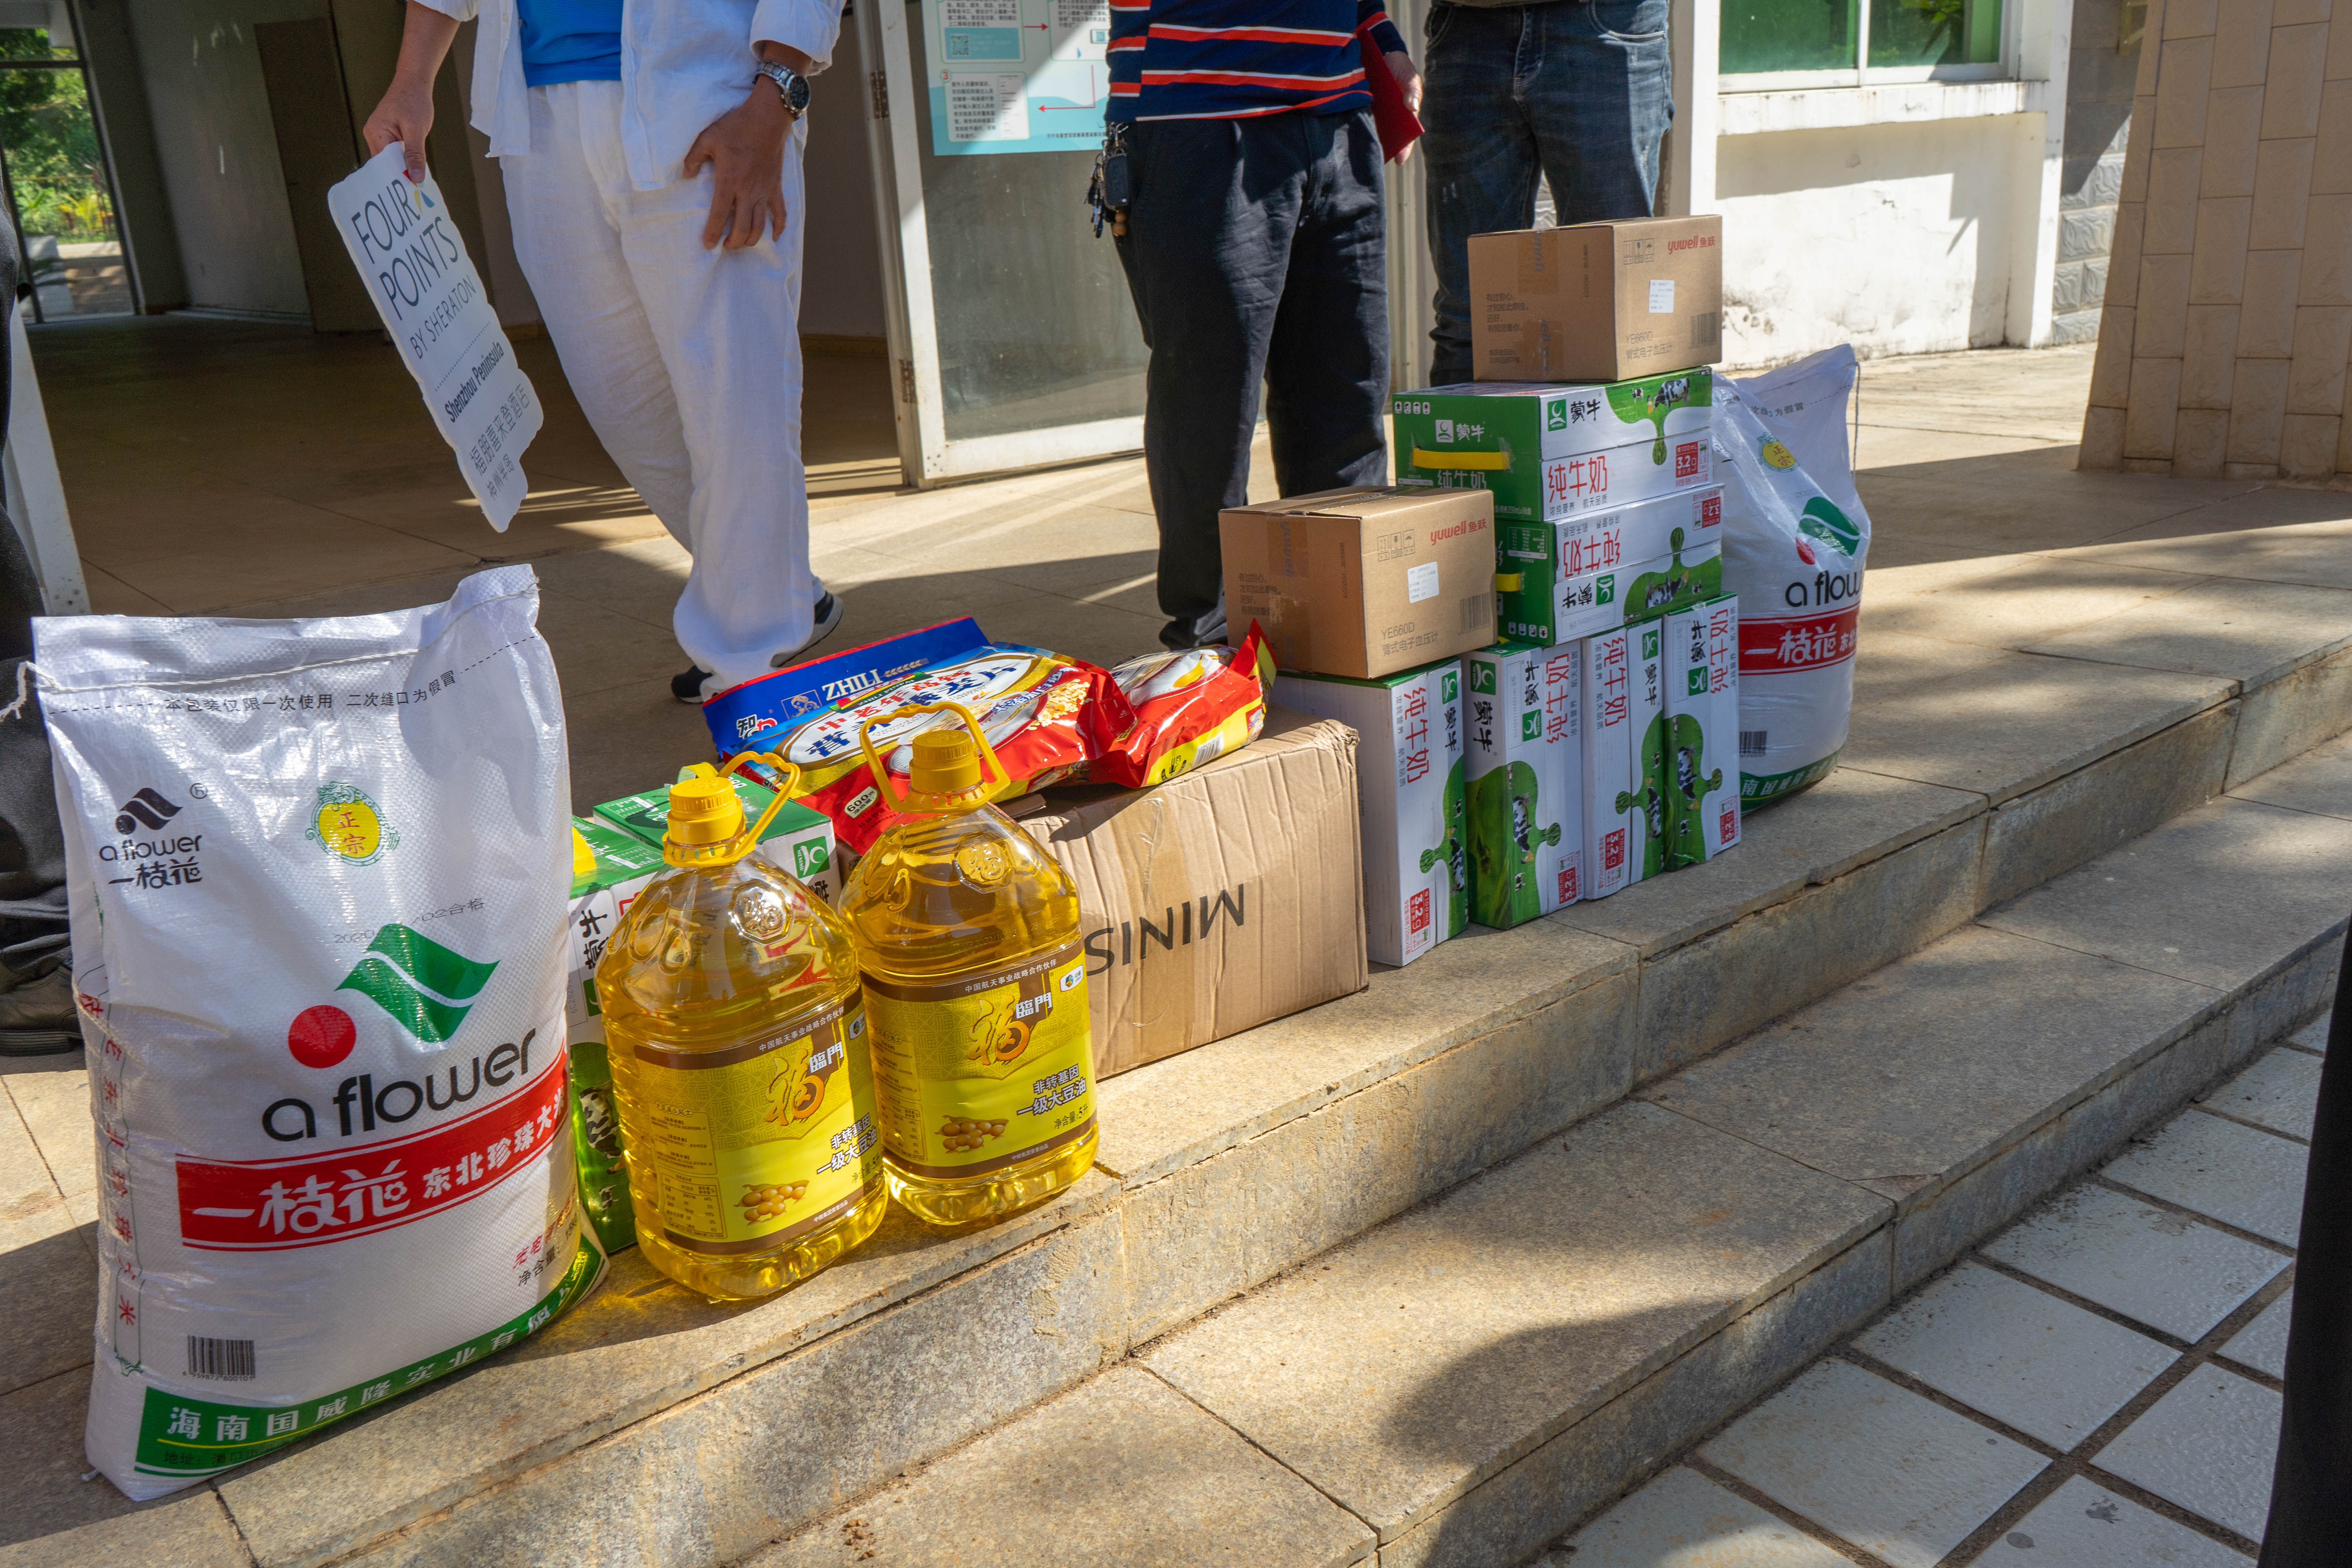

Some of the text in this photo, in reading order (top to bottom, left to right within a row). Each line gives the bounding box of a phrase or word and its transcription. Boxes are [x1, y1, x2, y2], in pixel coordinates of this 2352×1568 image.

[943, 71, 949, 80] 3
[351, 179, 420, 264] FOUR
[1668, 236, 1715, 254] yuwell 鱼跃
[379, 216, 459, 321] POINTS
[410, 274, 476, 359] BY SHERATON
[1625, 331, 1653, 346] YE660D
[1627, 343, 1673, 360] 臂式电子血压计
[445, 341, 505, 423] Shenzhou Peninsula
[469, 383, 530, 475] 福朋喜来登酒店
[1570, 398, 1602, 425] 蒙牛
[1456, 422, 1485, 443] 蒙牛
[1677, 454, 1697, 472] 3.2g
[1773, 441, 1791, 467] 正宗
[486, 453, 515, 502] 神州半岛
[1548, 455, 1608, 504] 纯牛奶
[1549, 494, 1608, 517] 浓纯营养 航天品质
[1702, 501, 1720, 517] 3.2g
[1430, 518, 1487, 546] yuwell 鱼跃
[1563, 514, 1621, 536] 浓纯营养 航天品质
[1563, 528, 1621, 579] 纯牛奶
[1562, 583, 1593, 609] 蒙牛
[1785, 570, 1863, 608] a flow
[1381, 622, 1415, 640] YE660D
[1383, 630, 1439, 656] 臂式电子血压计
[1690, 619, 1707, 663] 蒙牛
[1744, 623, 1837, 664] 一枝花
[1710, 609, 1729, 694] 纯牛奶
[164, 670, 457, 712] 本包装仅限一次使用 二次缝口为假冒
[817, 669, 971, 731] 中老年高钙
[822, 668, 884, 702] ZHILI
[857, 692, 882, 706] ZHILI
[883, 679, 916, 694] PINPAI
[1524, 660, 1539, 706] 蒙牛
[1546, 653, 1570, 744] 纯牛奶
[1570, 651, 1579, 736] 浓纯营养 航天品质
[1603, 638, 1626, 727] 纯牛奶
[1644, 664, 1657, 706] 蒙牛
[1404, 687, 1430, 784] 纯牛奶
[1444, 707, 1458, 752] 蒙牛
[1472, 701, 1493, 753] 蒙牛
[337, 811, 366, 855] 正宗
[1724, 813, 1734, 840] 3.2g
[99, 834, 203, 861] a flower
[1606, 833, 1619, 867] 3.2g
[107, 855, 203, 890] 一枝花
[1564, 870, 1575, 898] 3.2g
[1412, 894, 1423, 931] 3.2g
[964, 958, 1058, 993] 中国航天事业战略合作伙伴
[759, 1005, 846, 1052] 中国航天事业战略合作伙伴
[262, 1027, 536, 1142] a flower
[1016, 1077, 1087, 1117] 一级大豆油
[1033, 1063, 1080, 1095] 非转基因
[816, 1125, 878, 1175] 一级大豆油
[830, 1112, 871, 1150] 非转基因
[192, 1158, 412, 1235] 一枝花
[422, 1083, 566, 1200] 东北珍珠大米
[1011, 1142, 1049, 1161] 中粮集团荣誉出品
[813, 1200, 849, 1223] 中粮集团荣誉出品
